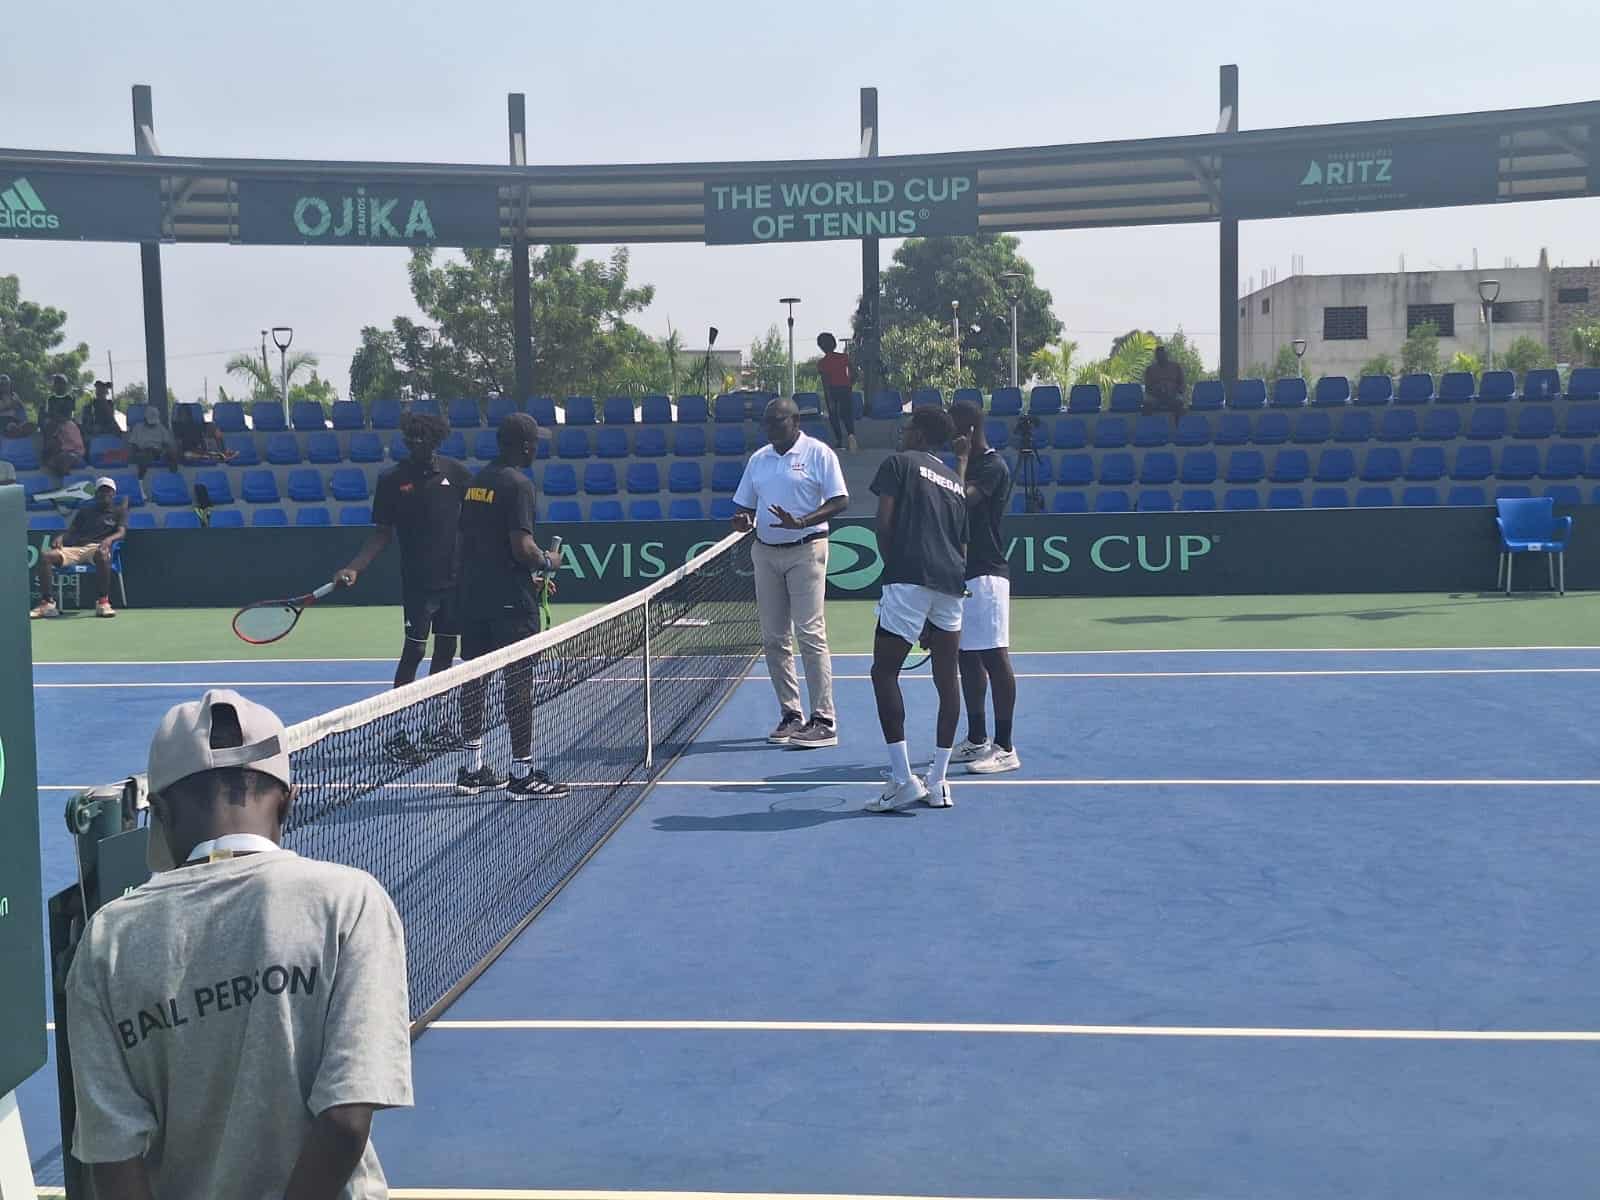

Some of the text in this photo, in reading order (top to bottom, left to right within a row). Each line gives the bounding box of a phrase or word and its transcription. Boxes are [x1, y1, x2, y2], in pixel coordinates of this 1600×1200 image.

[711, 176, 971, 210] THE WORLD CUP
[0, 208, 60, 229] didas
[752, 215, 795, 240] OF
[558, 541, 668, 579] AVIS
[1090, 535, 1212, 572] CUP
[117, 997, 189, 1050] BALL
